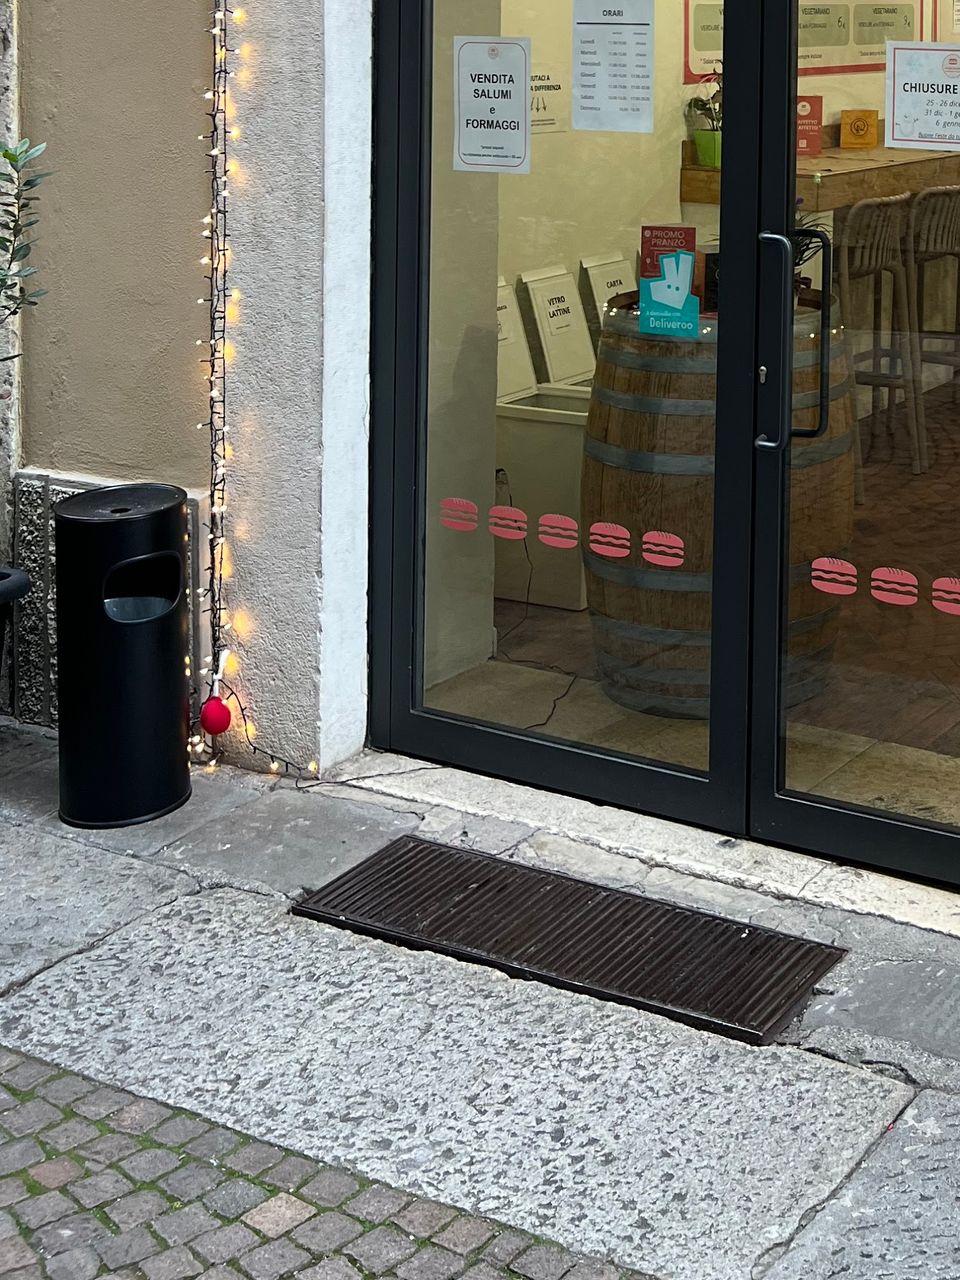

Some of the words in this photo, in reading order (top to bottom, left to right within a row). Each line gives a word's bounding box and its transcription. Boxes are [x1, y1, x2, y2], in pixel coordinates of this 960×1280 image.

[602, 9, 624, 17] ORARI
[470, 73, 515, 85] VENDITA
[473, 88, 512, 100] SALUMI
[902, 82, 958, 95] CHIUSURE
[926, 99, 935, 107] 25
[939, 100, 948, 108] 26
[489, 106, 496, 115] e
[465, 118, 520, 131] FORMAGGI
[652, 230, 685, 239] PROMO
[651, 238, 687, 247] PRANZO
[606, 279, 623, 289] CARTA
[547, 295, 566, 306] VETRO
[548, 306, 571, 319] LATTINE
[649, 317, 693, 330] Deliveroo
